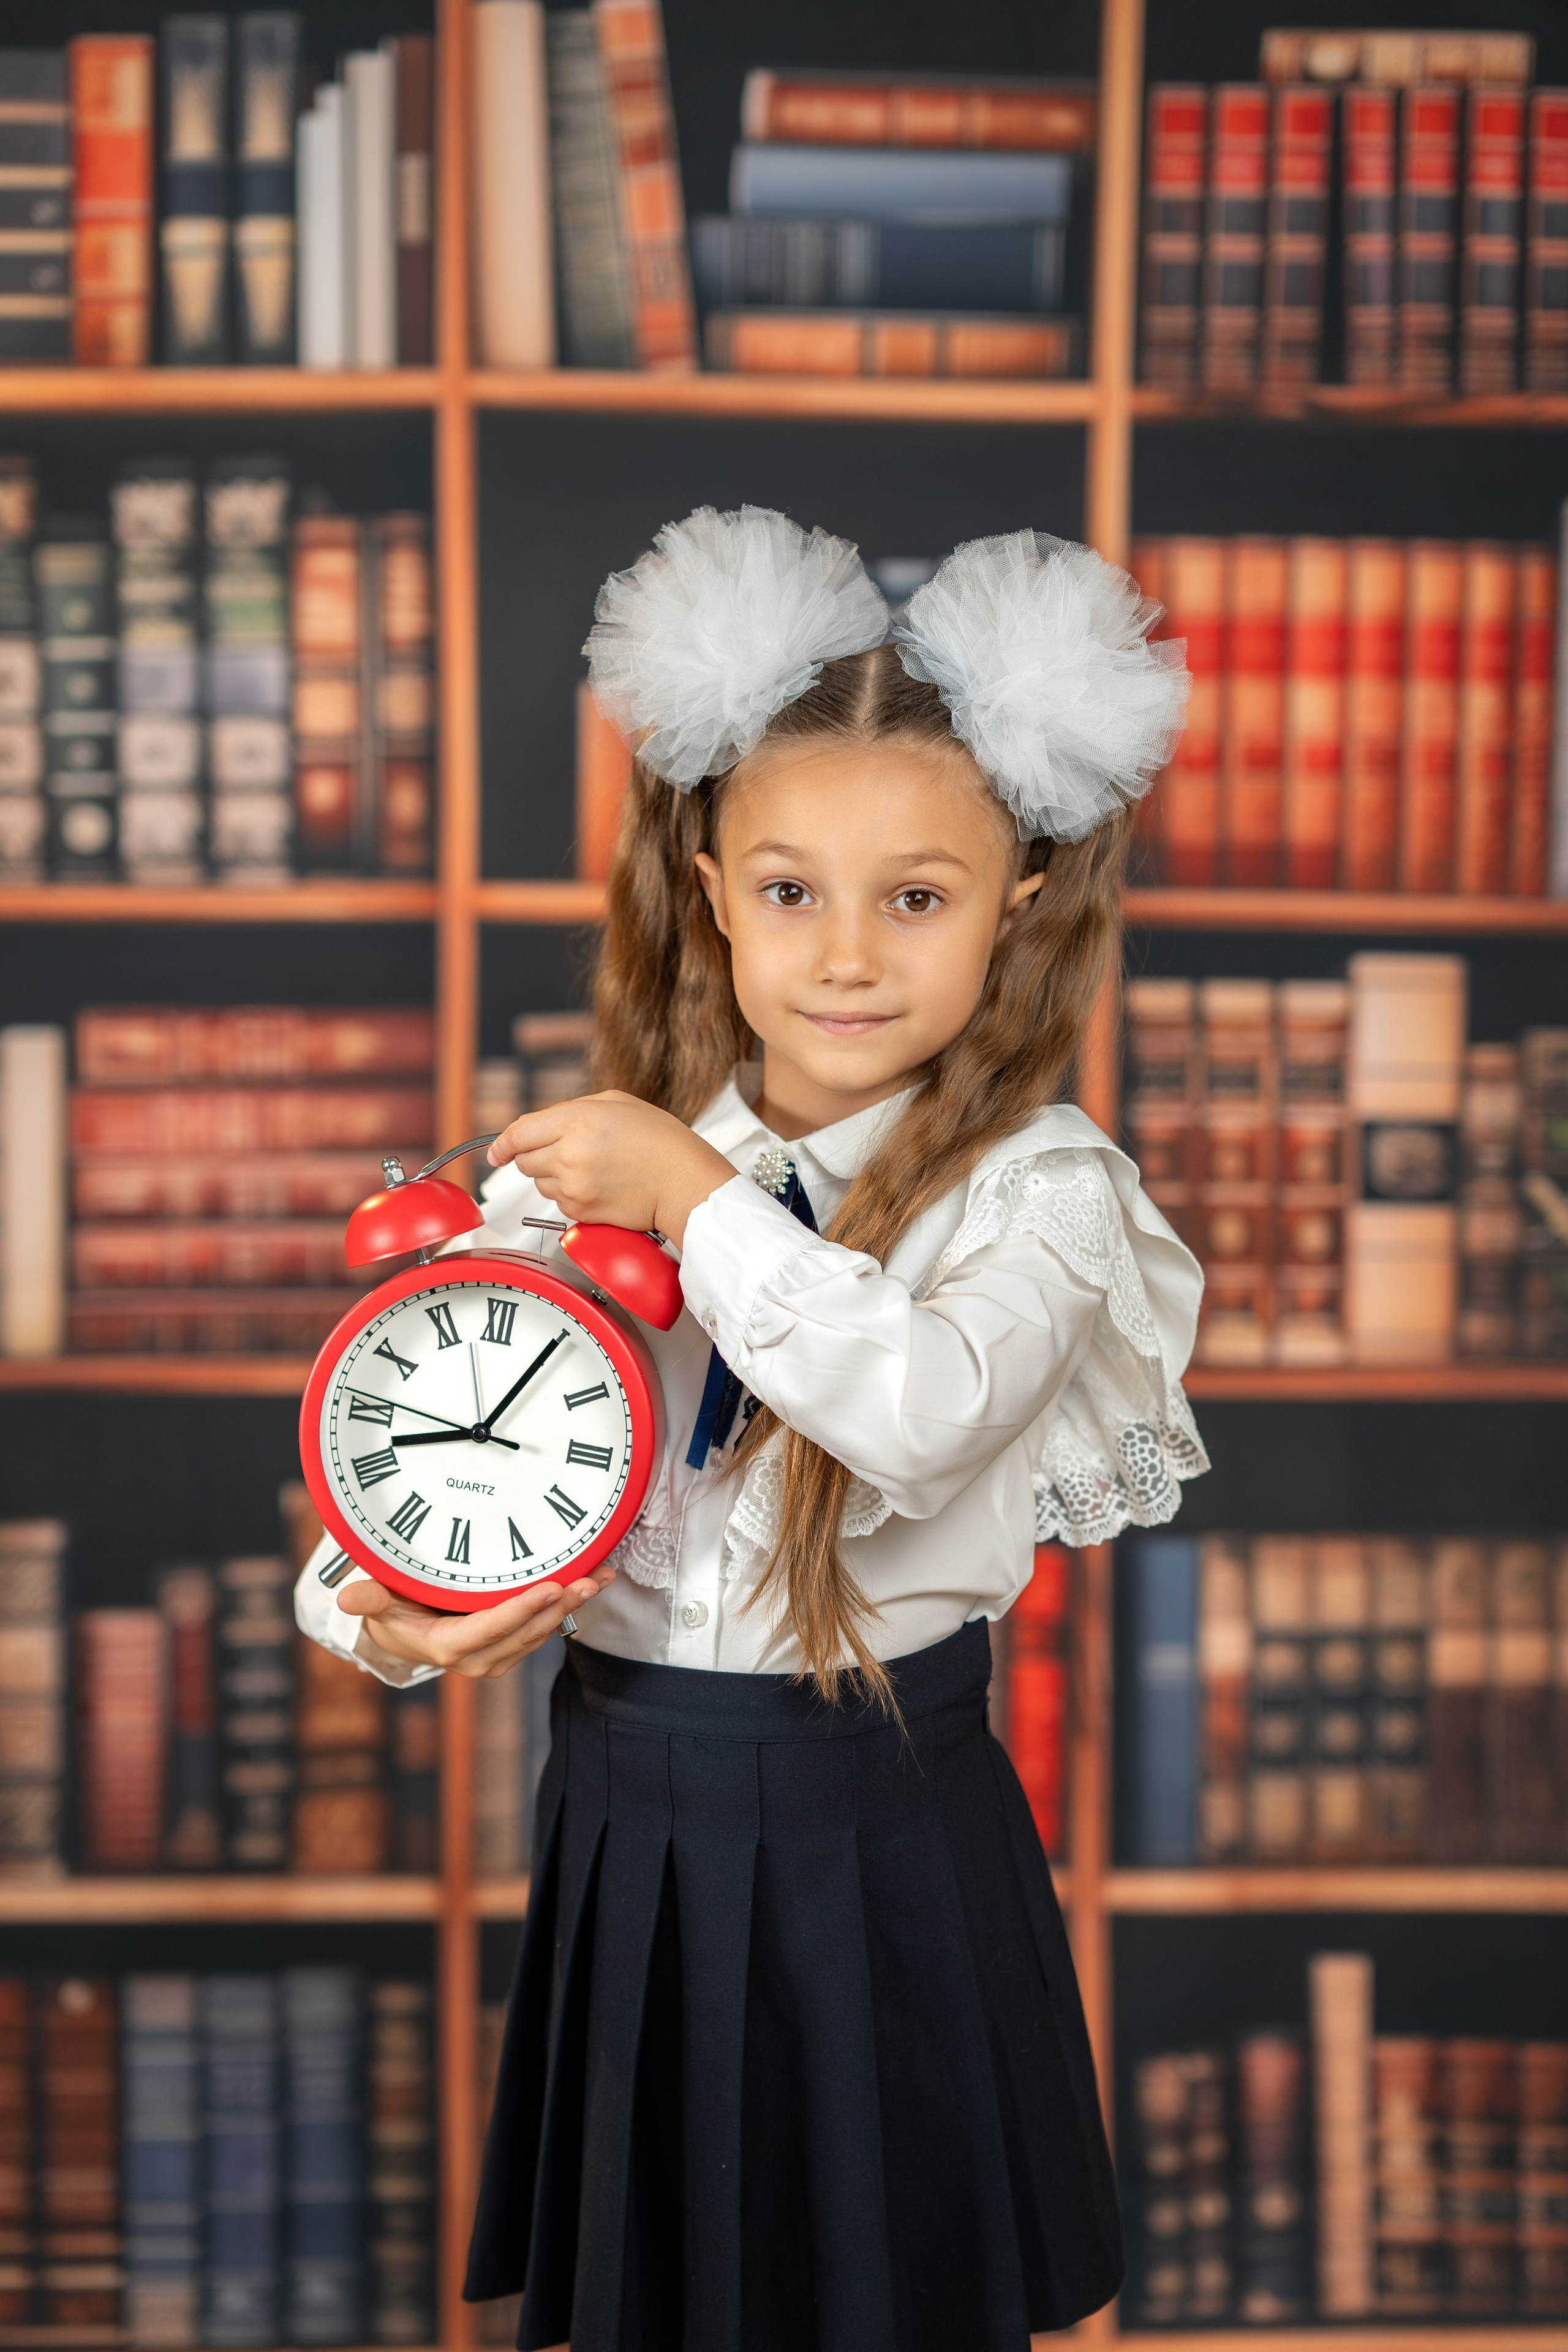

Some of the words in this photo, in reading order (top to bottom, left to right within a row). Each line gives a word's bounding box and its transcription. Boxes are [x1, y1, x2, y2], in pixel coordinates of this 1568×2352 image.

[424, 1301, 462, 1351] XI
[480, 1297, 519, 1346] XII
[372, 1336, 419, 1382] X
[347, 1395, 394, 1429] IX
[563, 1381, 611, 1411] II
[350, 1445, 401, 1493] VIII
[565, 1439, 614, 1472] III
[446, 1477, 496, 1496] QUARTZ
[543, 1483, 589, 1531] IV
[385, 1490, 432, 1545] VII
[445, 1517, 470, 1565] VI
[508, 1516, 534, 1562] V
